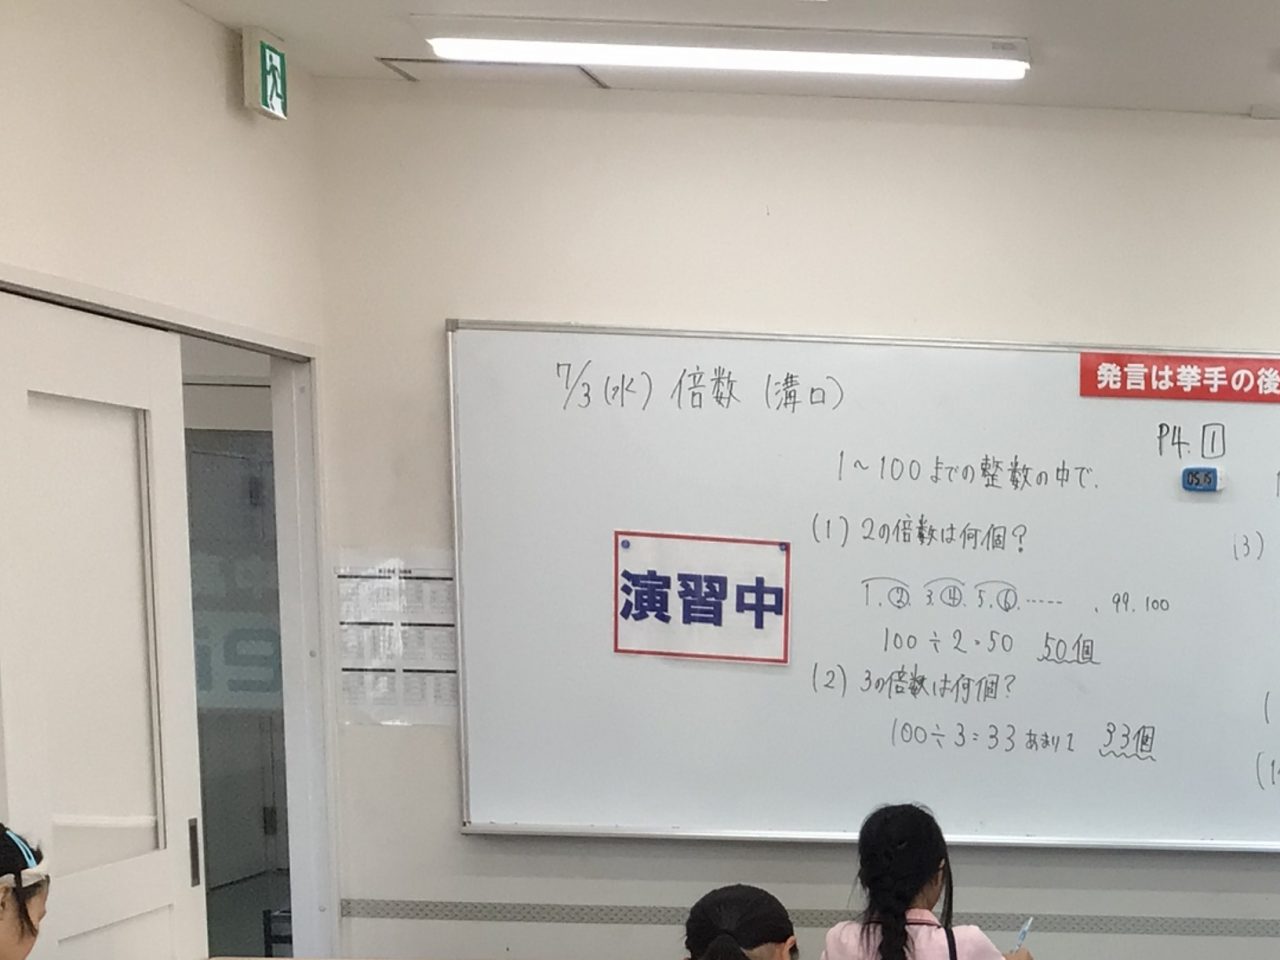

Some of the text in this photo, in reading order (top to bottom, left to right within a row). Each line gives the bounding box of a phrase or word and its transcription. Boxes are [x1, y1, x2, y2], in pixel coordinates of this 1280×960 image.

[671, 365, 741, 409] 倍数
[619, 569, 784, 630] 演習中
